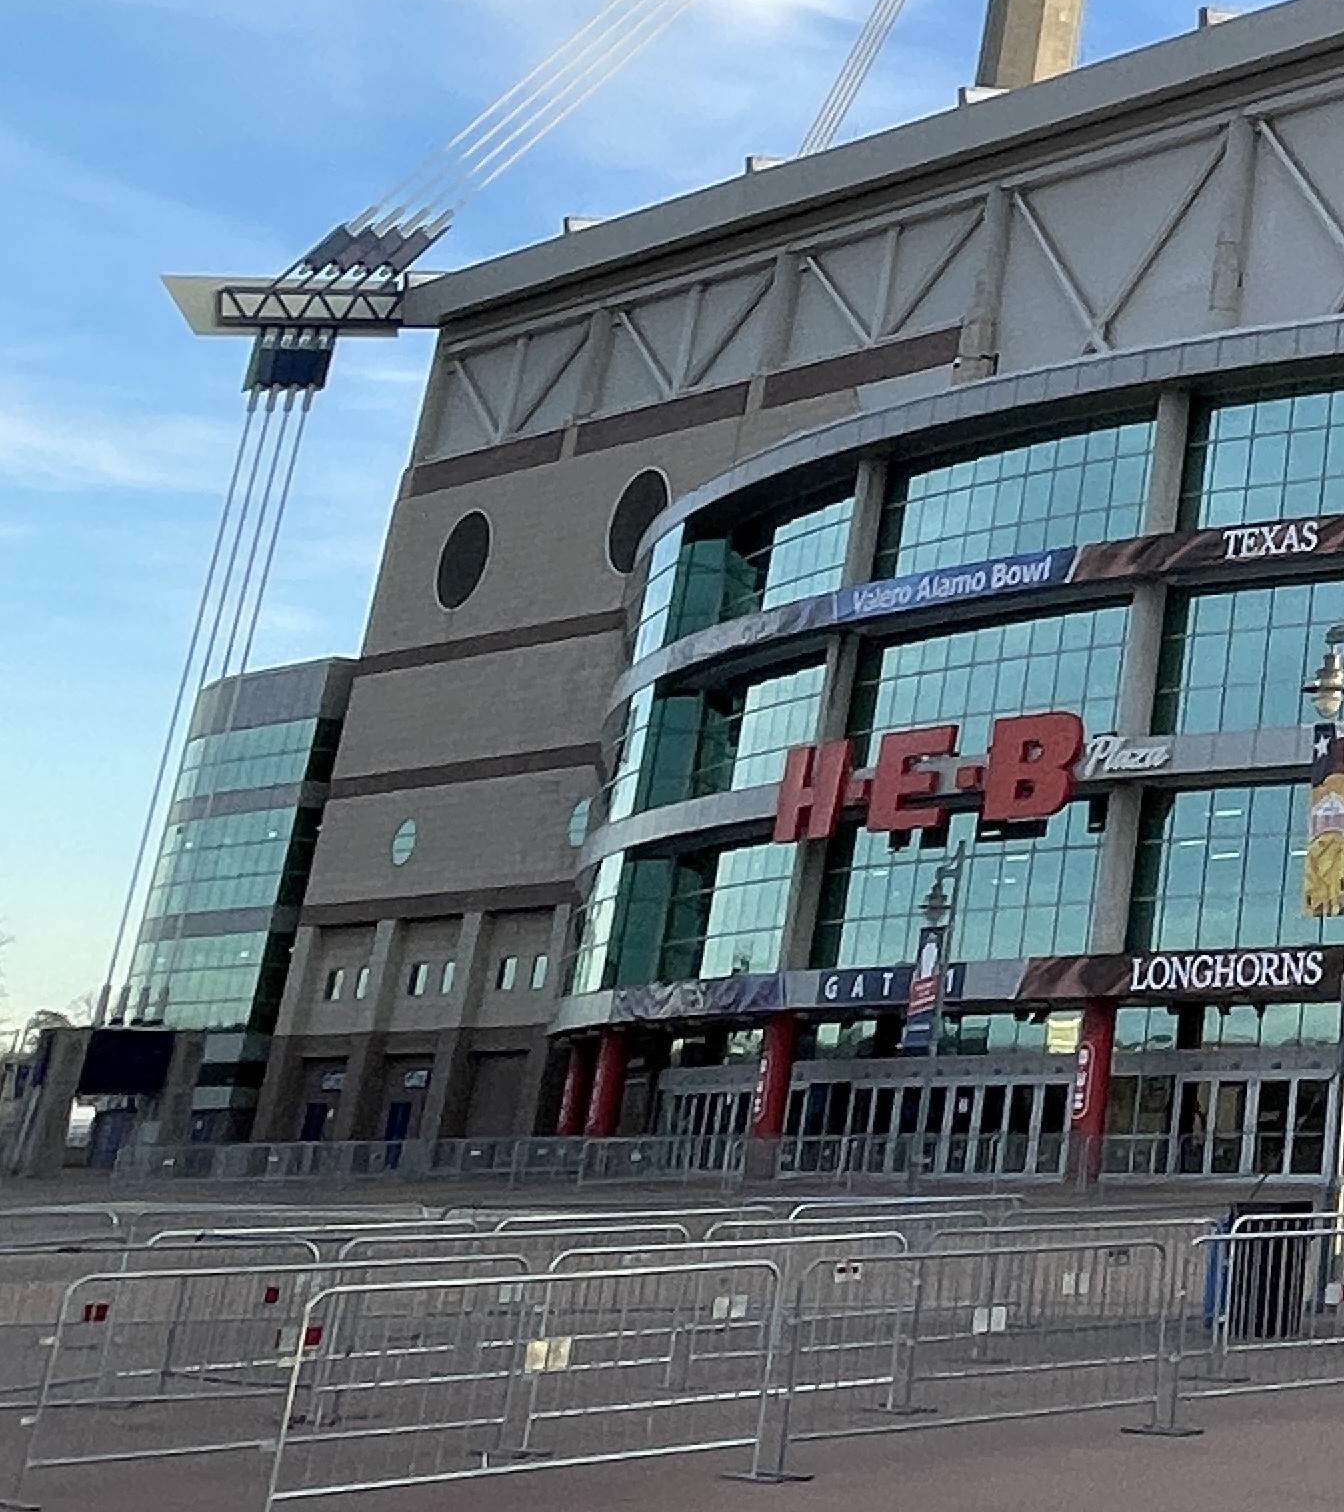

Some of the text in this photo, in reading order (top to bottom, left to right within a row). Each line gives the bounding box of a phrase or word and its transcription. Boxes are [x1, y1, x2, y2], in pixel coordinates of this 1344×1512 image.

[1222, 521, 1319, 560] TEXAS
[853, 554, 1052, 614] Valero Alamo Bowl
[1084, 735, 1172, 780] Plaza
[824, 972, 894, 1000] GAT
[1130, 951, 1324, 991] LONGHORNS
